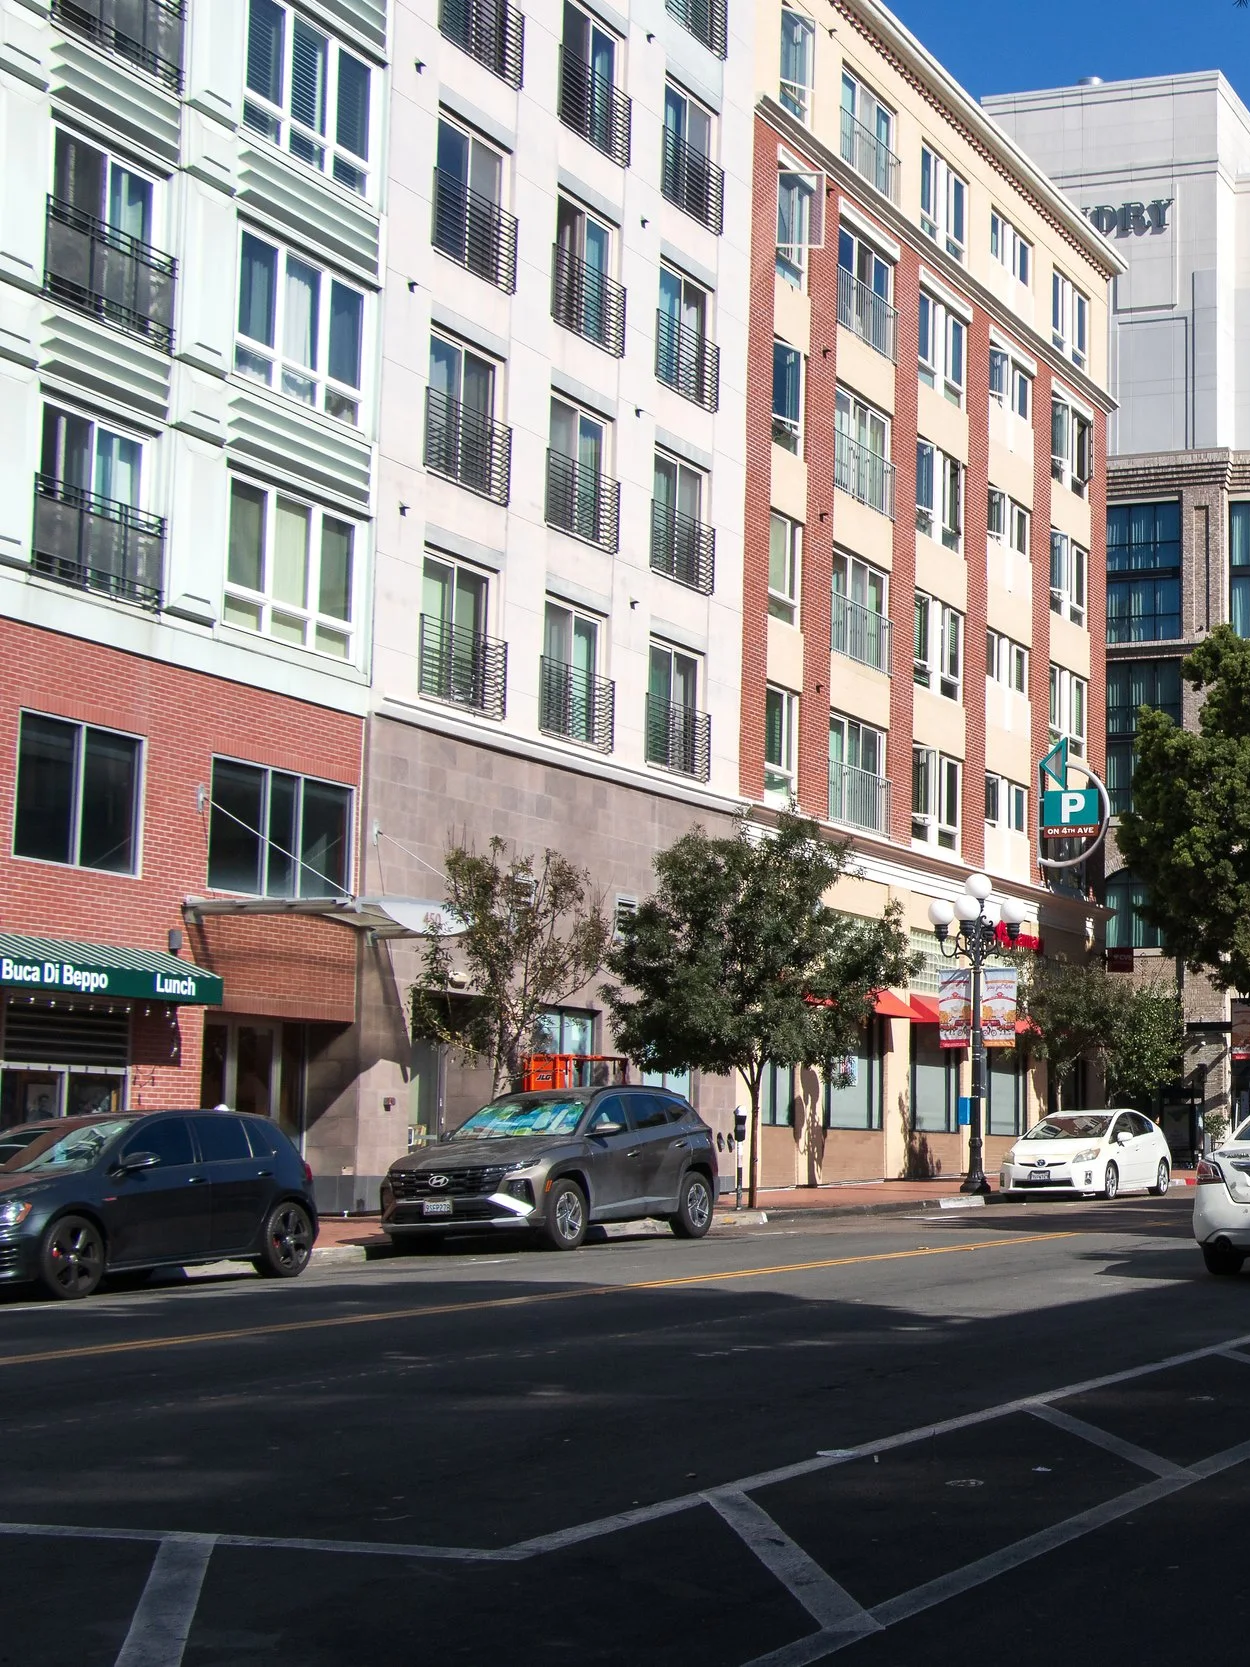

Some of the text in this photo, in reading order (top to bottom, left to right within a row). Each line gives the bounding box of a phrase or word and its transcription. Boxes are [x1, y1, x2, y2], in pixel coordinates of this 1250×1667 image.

[1081, 198, 1175, 234] DRY
[1061, 792, 1086, 823] P
[1061, 826, 1076, 834] 4TH
[1077, 826, 1095, 834] AVE
[1, 958, 109, 992] Buca Di Beppo
[156, 973, 196, 996] Lunch
